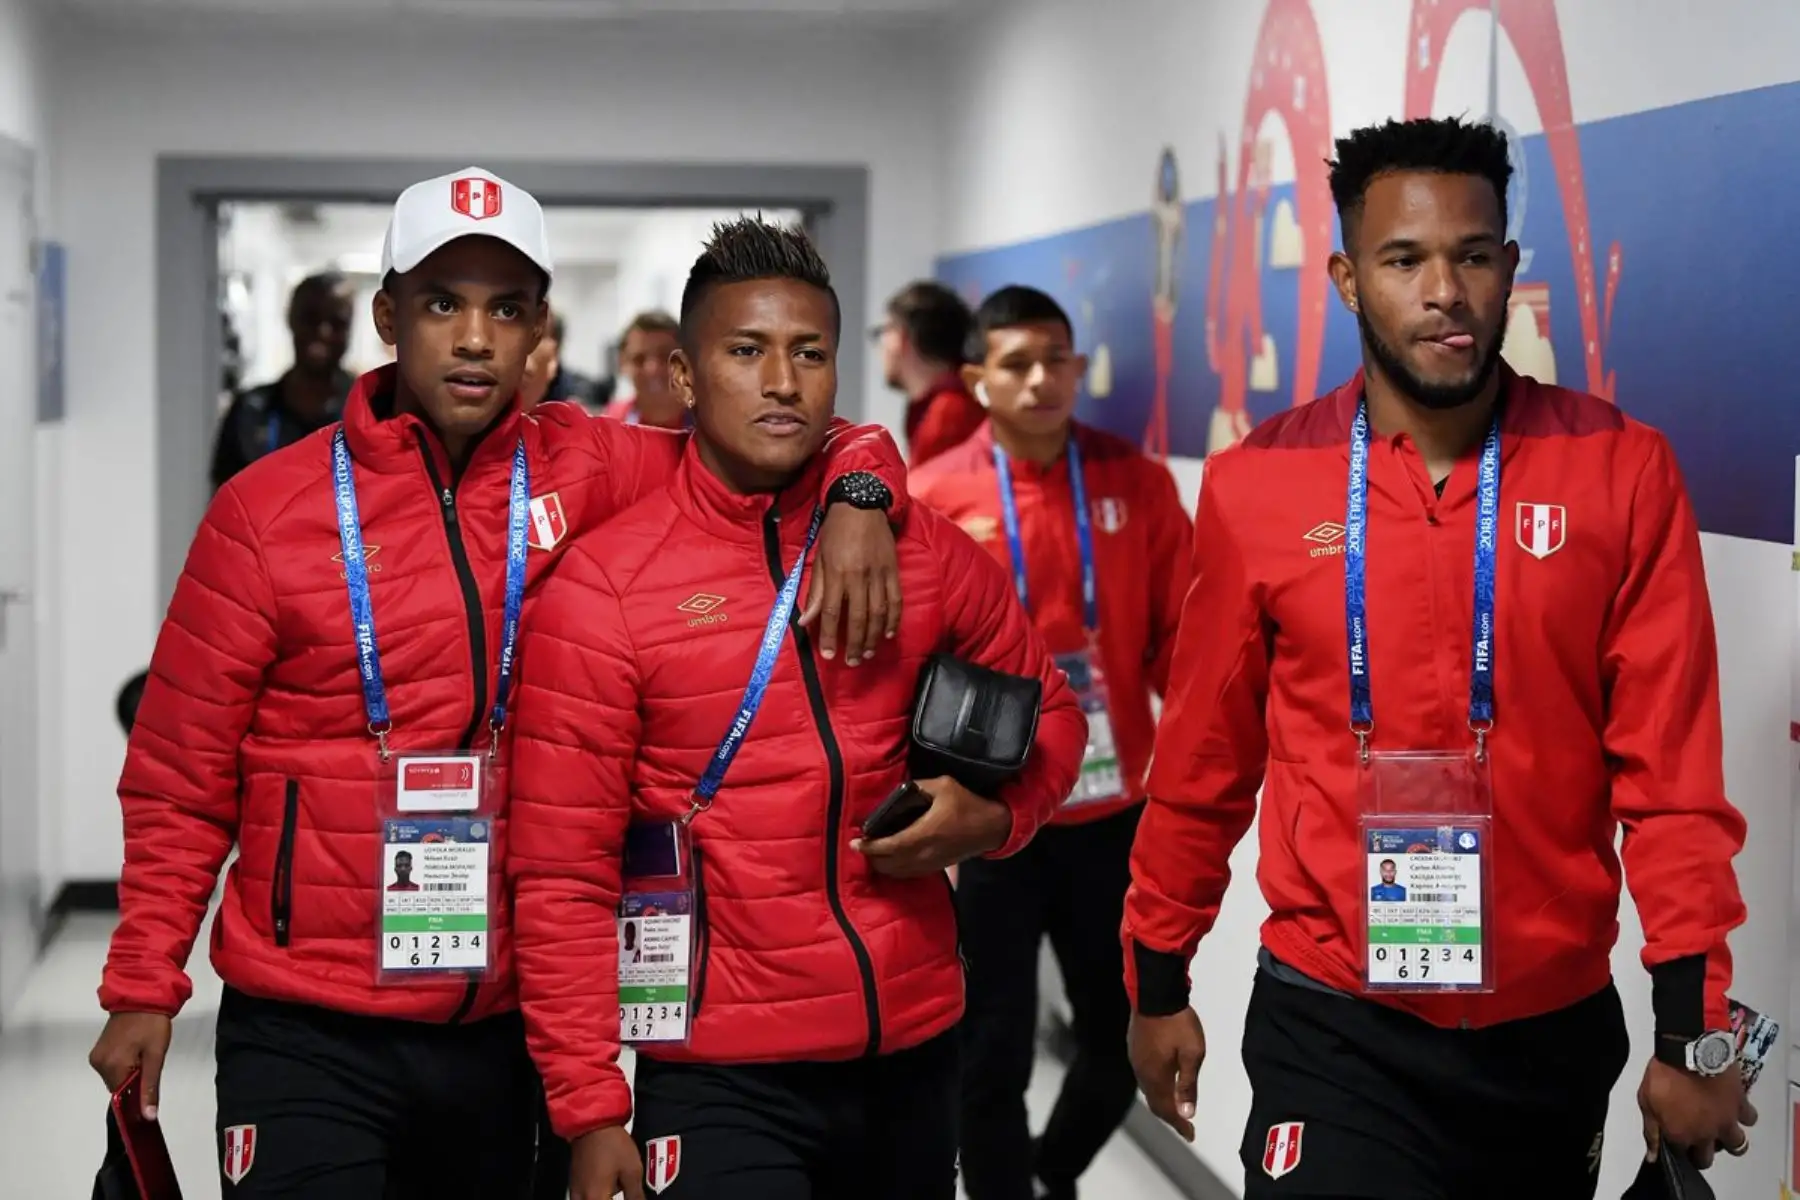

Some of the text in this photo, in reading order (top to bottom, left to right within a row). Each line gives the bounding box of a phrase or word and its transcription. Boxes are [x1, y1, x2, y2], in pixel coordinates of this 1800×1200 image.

[1351, 440, 1365, 490] WORLD
[337, 483, 352, 509] CUP
[1350, 493, 1361, 520] FIFA
[1481, 486, 1494, 515] FIFA
[342, 512, 359, 561] RUSSIA
[1349, 523, 1361, 553] 2018
[1480, 518, 1492, 549] 2018
[1310, 543, 1346, 558] umbr
[687, 612, 728, 628] umbro
[358, 624, 374, 680] FIFA.com
[1351, 617, 1364, 676] FIFA.com
[1476, 612, 1489, 671] FIFA.com
[718, 709, 751, 760] FIFA.com
[390, 936, 400, 949] 0
[431, 935, 440, 948] 2
[451, 935, 460, 948] 3
[470, 935, 480, 948] 4
[1376, 948, 1387, 961] 0
[1420, 948, 1430, 961] 2
[1442, 948, 1451, 961] 3
[1463, 948, 1474, 961] 4
[410, 953, 440, 966] 6 7
[1398, 965, 1430, 978] 6 7
[646, 1006, 653, 1019] 2
[661, 1006, 668, 1019] 3
[674, 1007, 682, 1018] 4
[631, 1023, 653, 1036] 6 7
